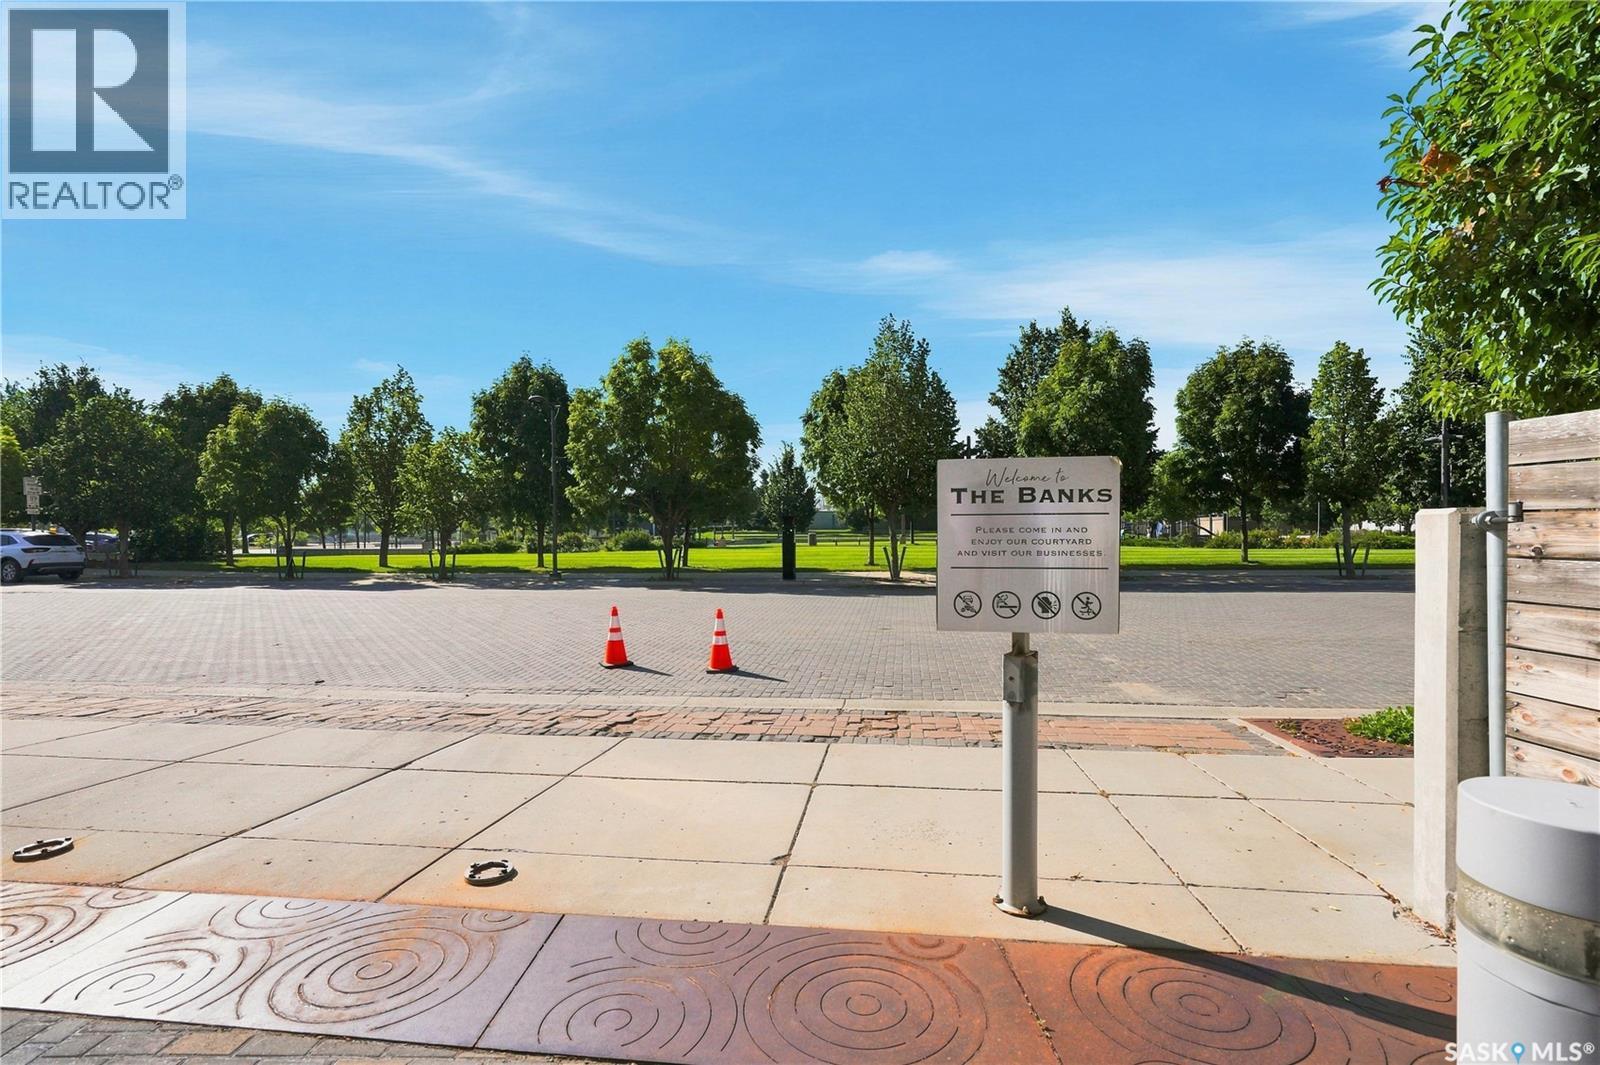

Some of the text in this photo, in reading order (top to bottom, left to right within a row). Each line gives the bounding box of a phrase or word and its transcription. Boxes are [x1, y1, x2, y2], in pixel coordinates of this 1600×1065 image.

[985, 466, 1069, 487] Welcome to
[951, 487, 1113, 504] THE BANKS
[975, 526, 1015, 534] PLEASE
[971, 538, 1092, 546] ENJOY OUR COURTYARD
